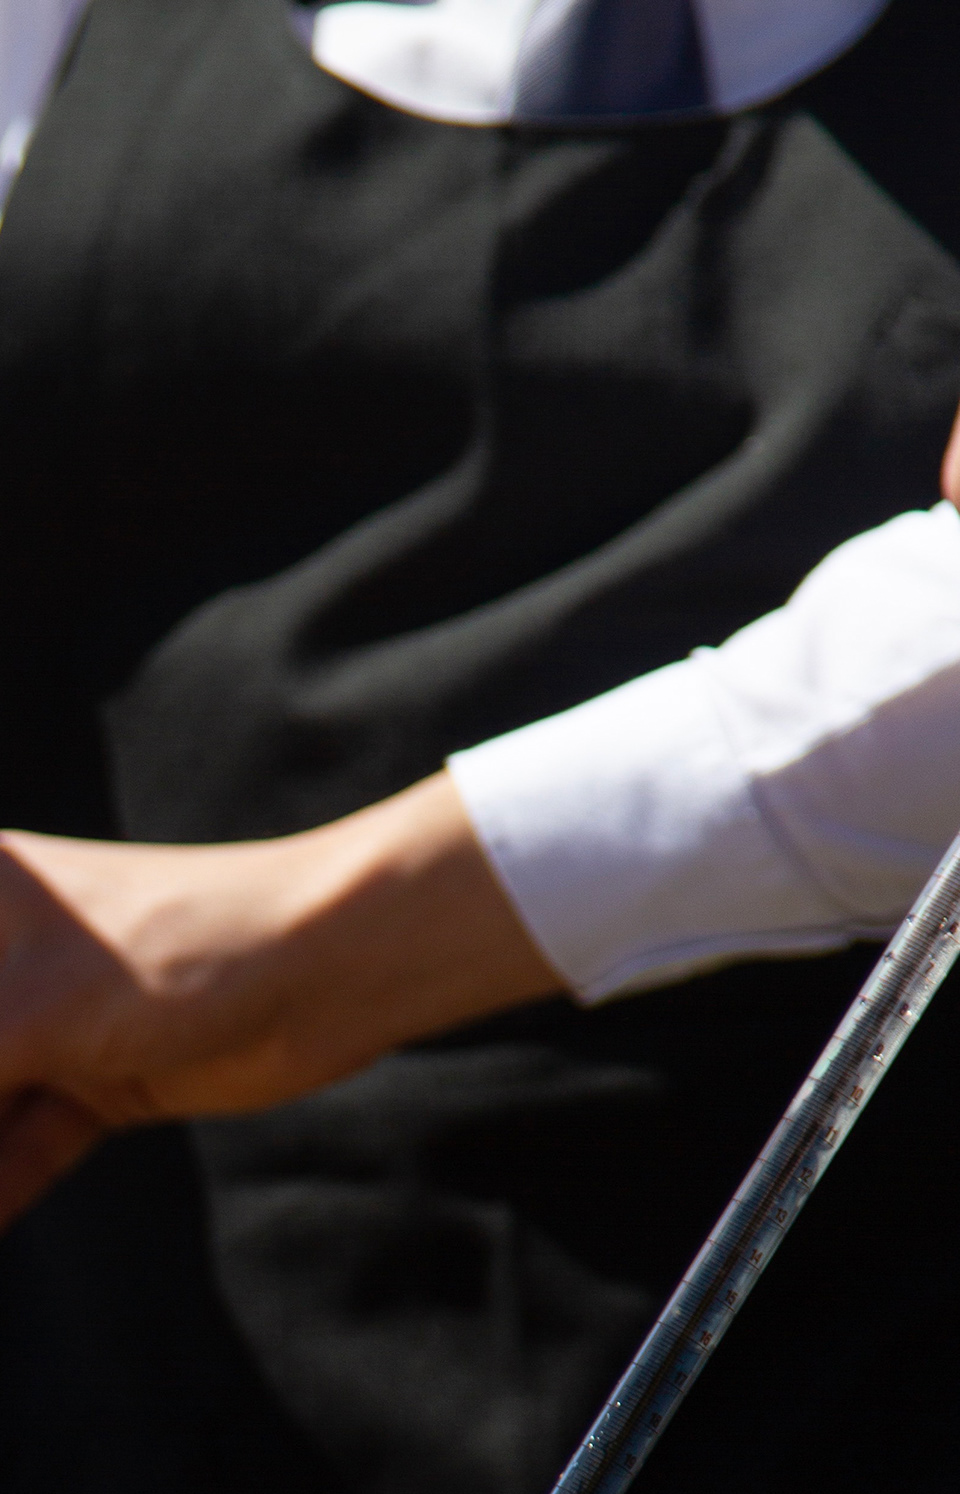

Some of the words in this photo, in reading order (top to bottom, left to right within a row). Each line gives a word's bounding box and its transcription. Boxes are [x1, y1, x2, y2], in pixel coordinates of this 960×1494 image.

[924, 961, 935, 974] 7
[900, 1002, 909, 1016] 8
[851, 1084, 864, 1100] 10
[825, 1125, 839, 1145] 11
[800, 1167, 814, 1183] 12
[775, 1207, 788, 1224] 13
[750, 1248, 763, 1264] 14
[725, 1289, 738, 1305] 15
[700, 1330, 713, 1346] 16
[674, 1371, 688, 1388] 17
[649, 1412, 662, 1428] 18
